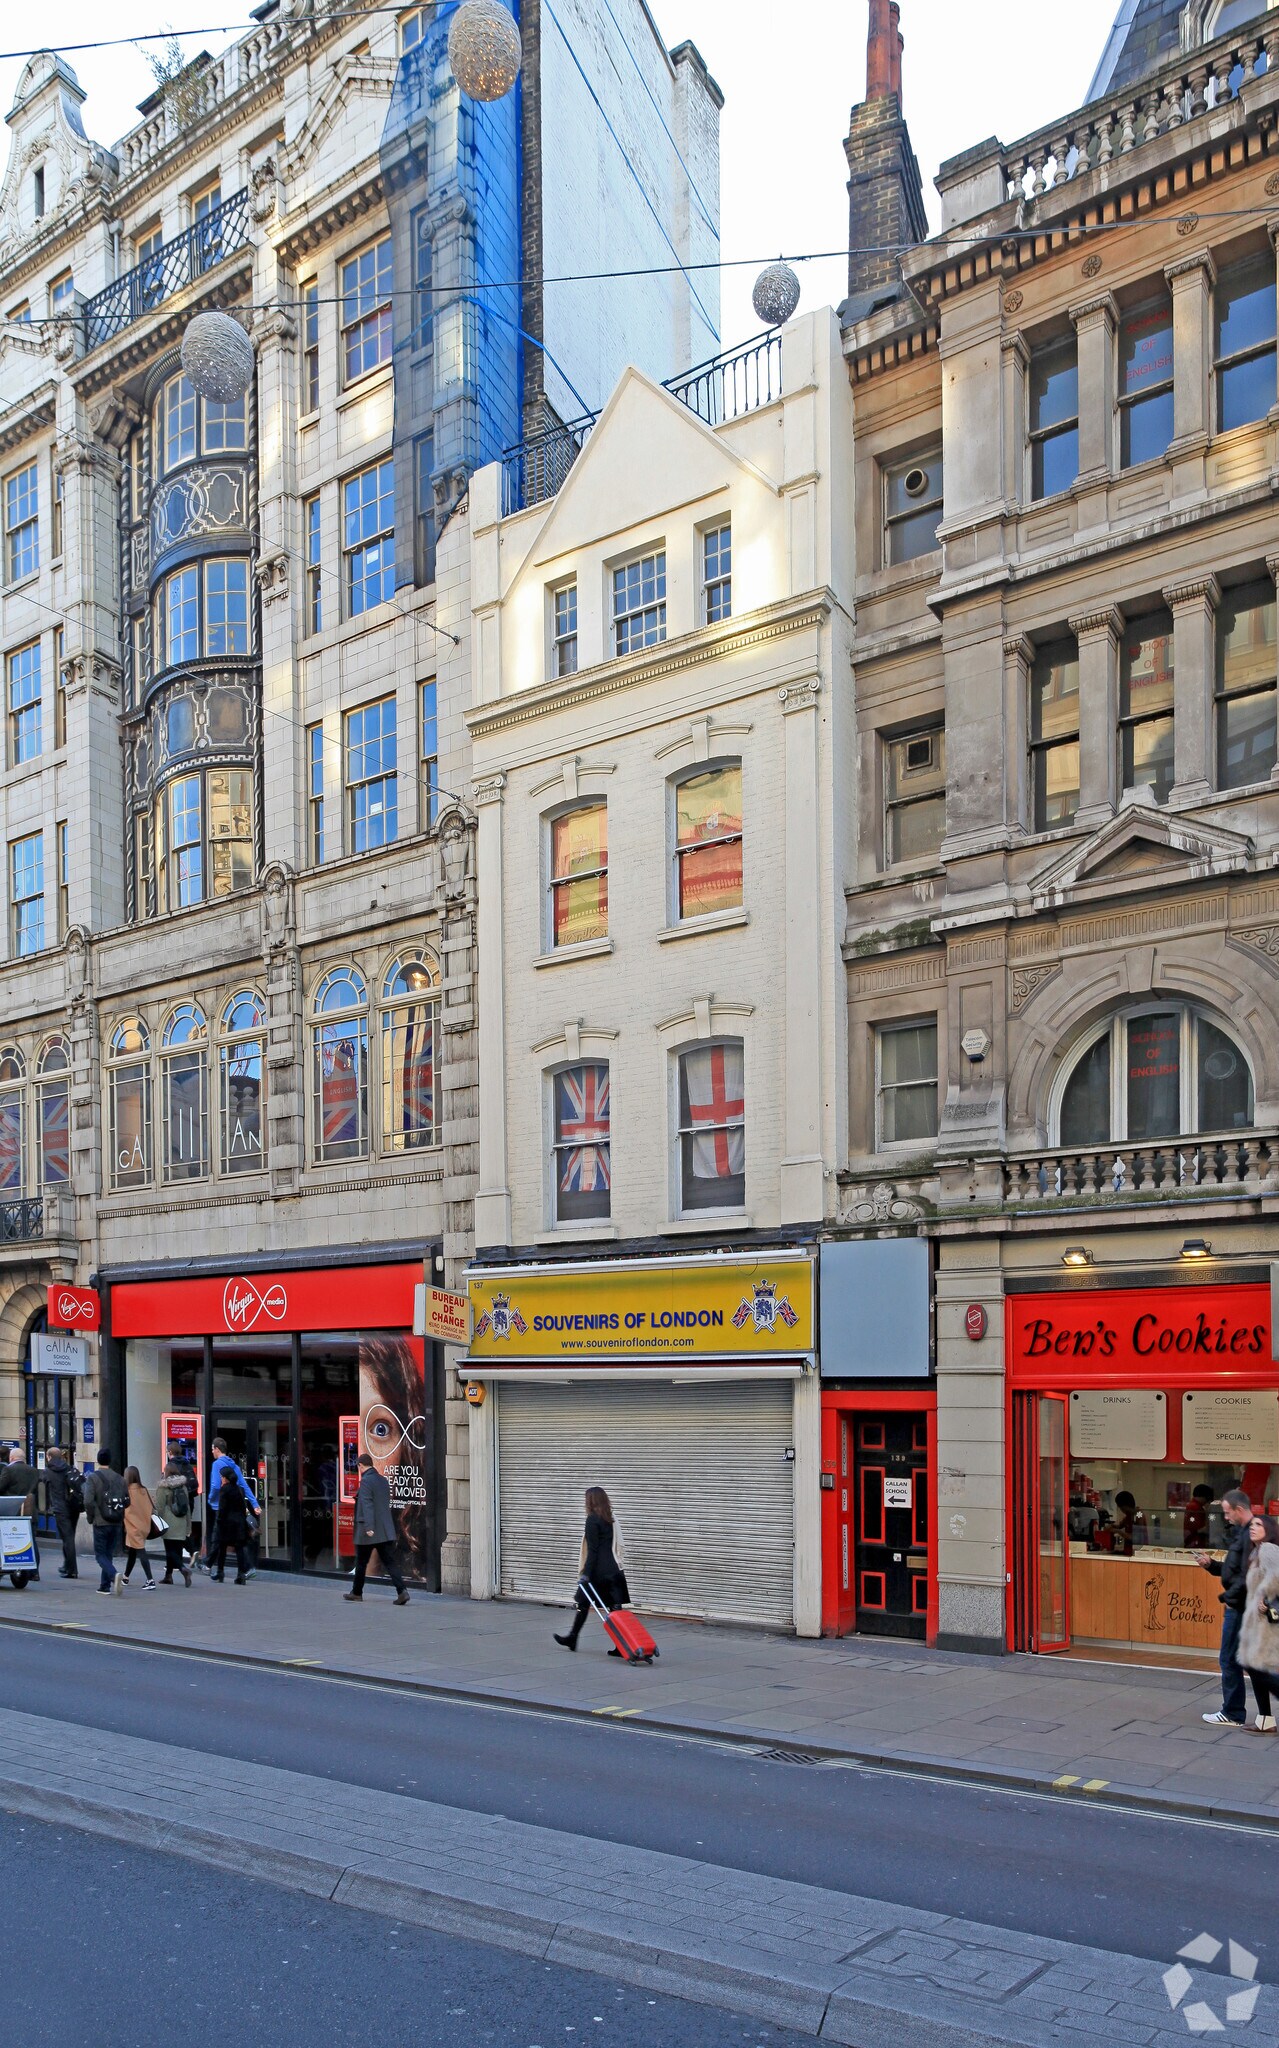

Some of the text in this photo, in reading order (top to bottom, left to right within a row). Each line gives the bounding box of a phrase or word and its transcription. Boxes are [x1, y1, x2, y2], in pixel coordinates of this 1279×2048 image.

[1141, 339, 1157, 352] OF
[1125, 355, 1173, 379] ENGLISH
[1128, 638, 1174, 656] SCHOOL
[1143, 657, 1159, 669] OF
[1128, 671, 1174, 689] ENGLISH
[1146, 1048, 1161, 1060] OF
[1131, 1064, 1178, 1078] ENGLISH
[329, 1086, 352, 1095] ENGLISH
[227, 1285, 255, 1323] Virgin
[266, 1297, 284, 1305] media
[432, 1290, 465, 1308] BUREAU
[443, 1303, 455, 1315] DE
[431, 1311, 465, 1328] CHANGE
[533, 1309, 723, 1331] SOUVENIRS OF LONDON
[1023, 1311, 1266, 1357] Ben's Cookies
[560, 1336, 694, 1348] www.souveniroflondon.com
[1103, 1396, 1132, 1404] DRINKS
[1214, 1397, 1252, 1405] COOKIES
[1215, 1433, 1251, 1441] SPECIALS
[891, 1454, 906, 1462] 139
[383, 1465, 419, 1476] ARE YOU
[410, 1476, 424, 1487] TO
[395, 1486, 427, 1498] MOVED
[1168, 1592, 1203, 1608] Ben's
[1169, 1606, 1216, 1624] Cookies
